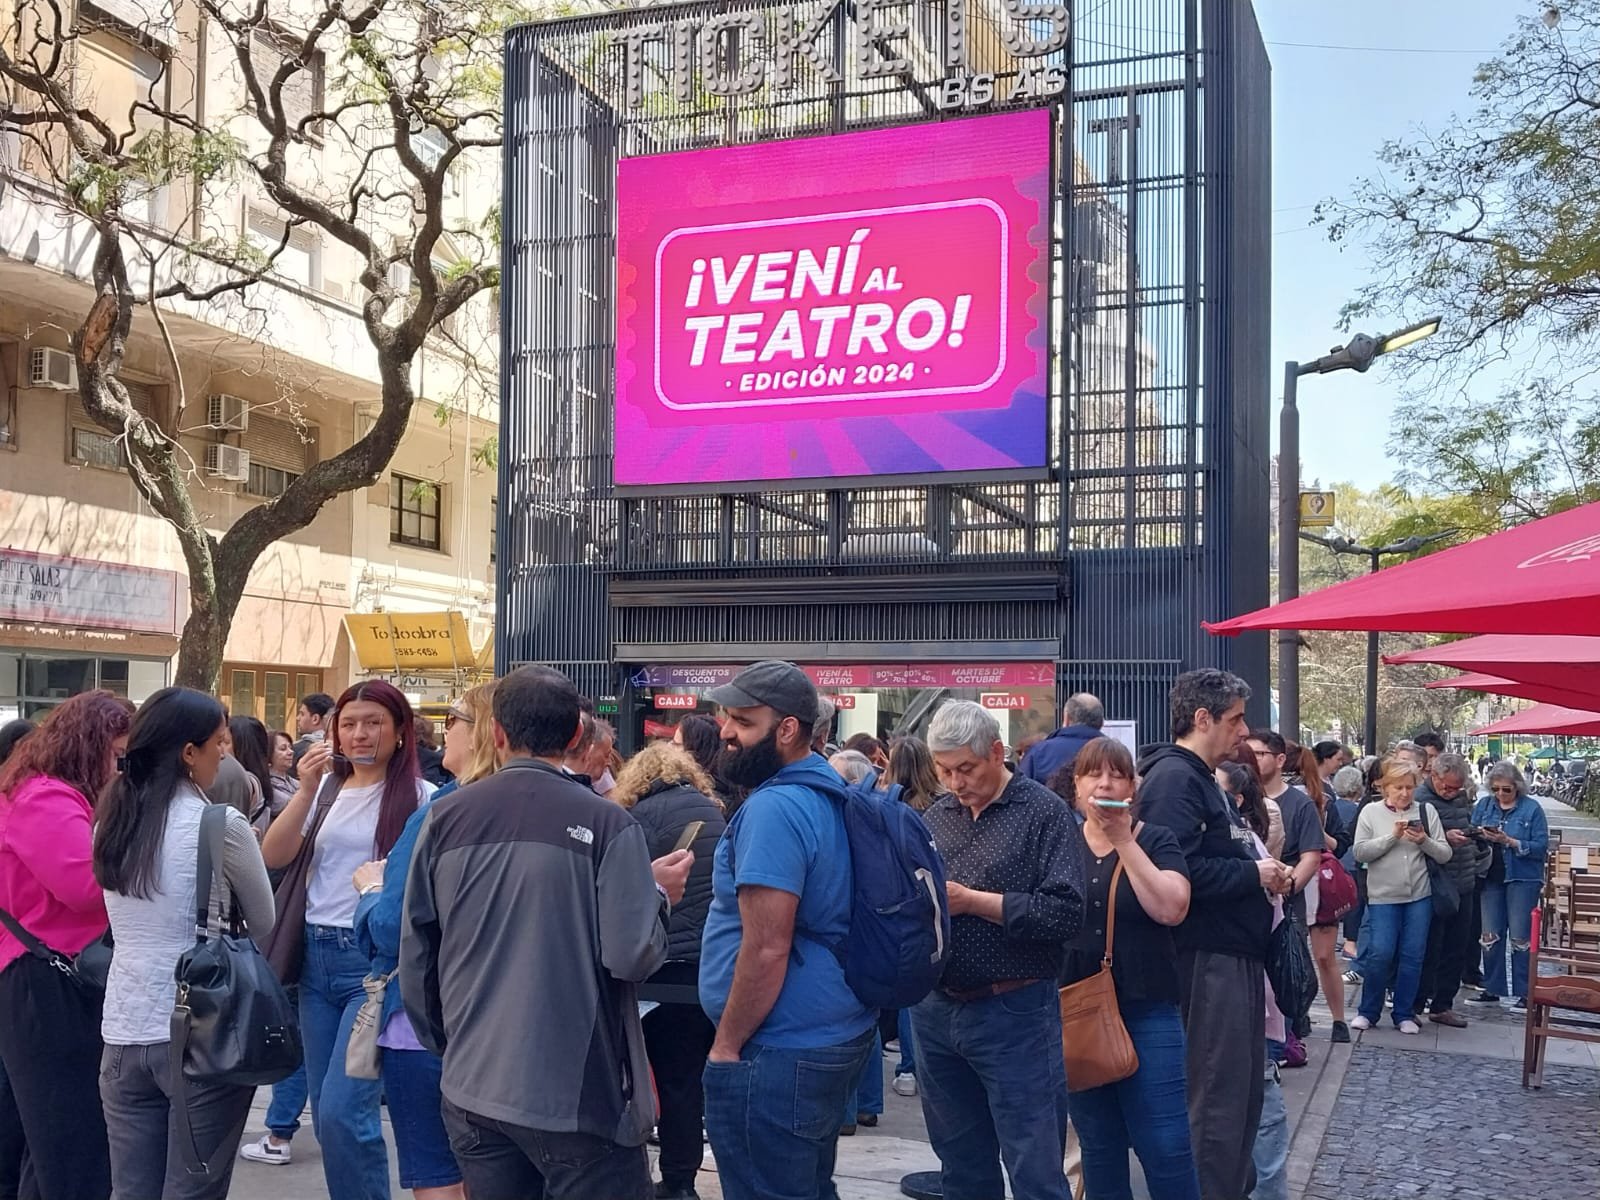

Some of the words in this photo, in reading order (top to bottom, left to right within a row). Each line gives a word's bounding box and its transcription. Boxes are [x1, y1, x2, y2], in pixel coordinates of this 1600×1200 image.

[940, 72, 995, 110] BS
[1007, 62, 1068, 101] AS
[684, 228, 871, 307] ¡VENÍ
[862, 266, 903, 294] AL
[684, 294, 972, 366] TEATRO!
[739, 364, 847, 392] EDICIÓN
[852, 361, 915, 385] 2024
[672, 669, 730, 677] DESCUENTOS
[842, 669, 854, 677] AL
[951, 668, 991, 676] MARTES
[991, 667, 1007, 676] DE
[685, 676, 716, 684] LOCOS
[818, 677, 853, 685] TEATRO
[956, 675, 1001, 684] OCTUBRE
[658, 697, 685, 706] CAJA
[686, 697, 693, 706] 3
[845, 697, 852, 707] 2
[987, 697, 1018, 707] CAJA
[1020, 697, 1025, 706] 1
